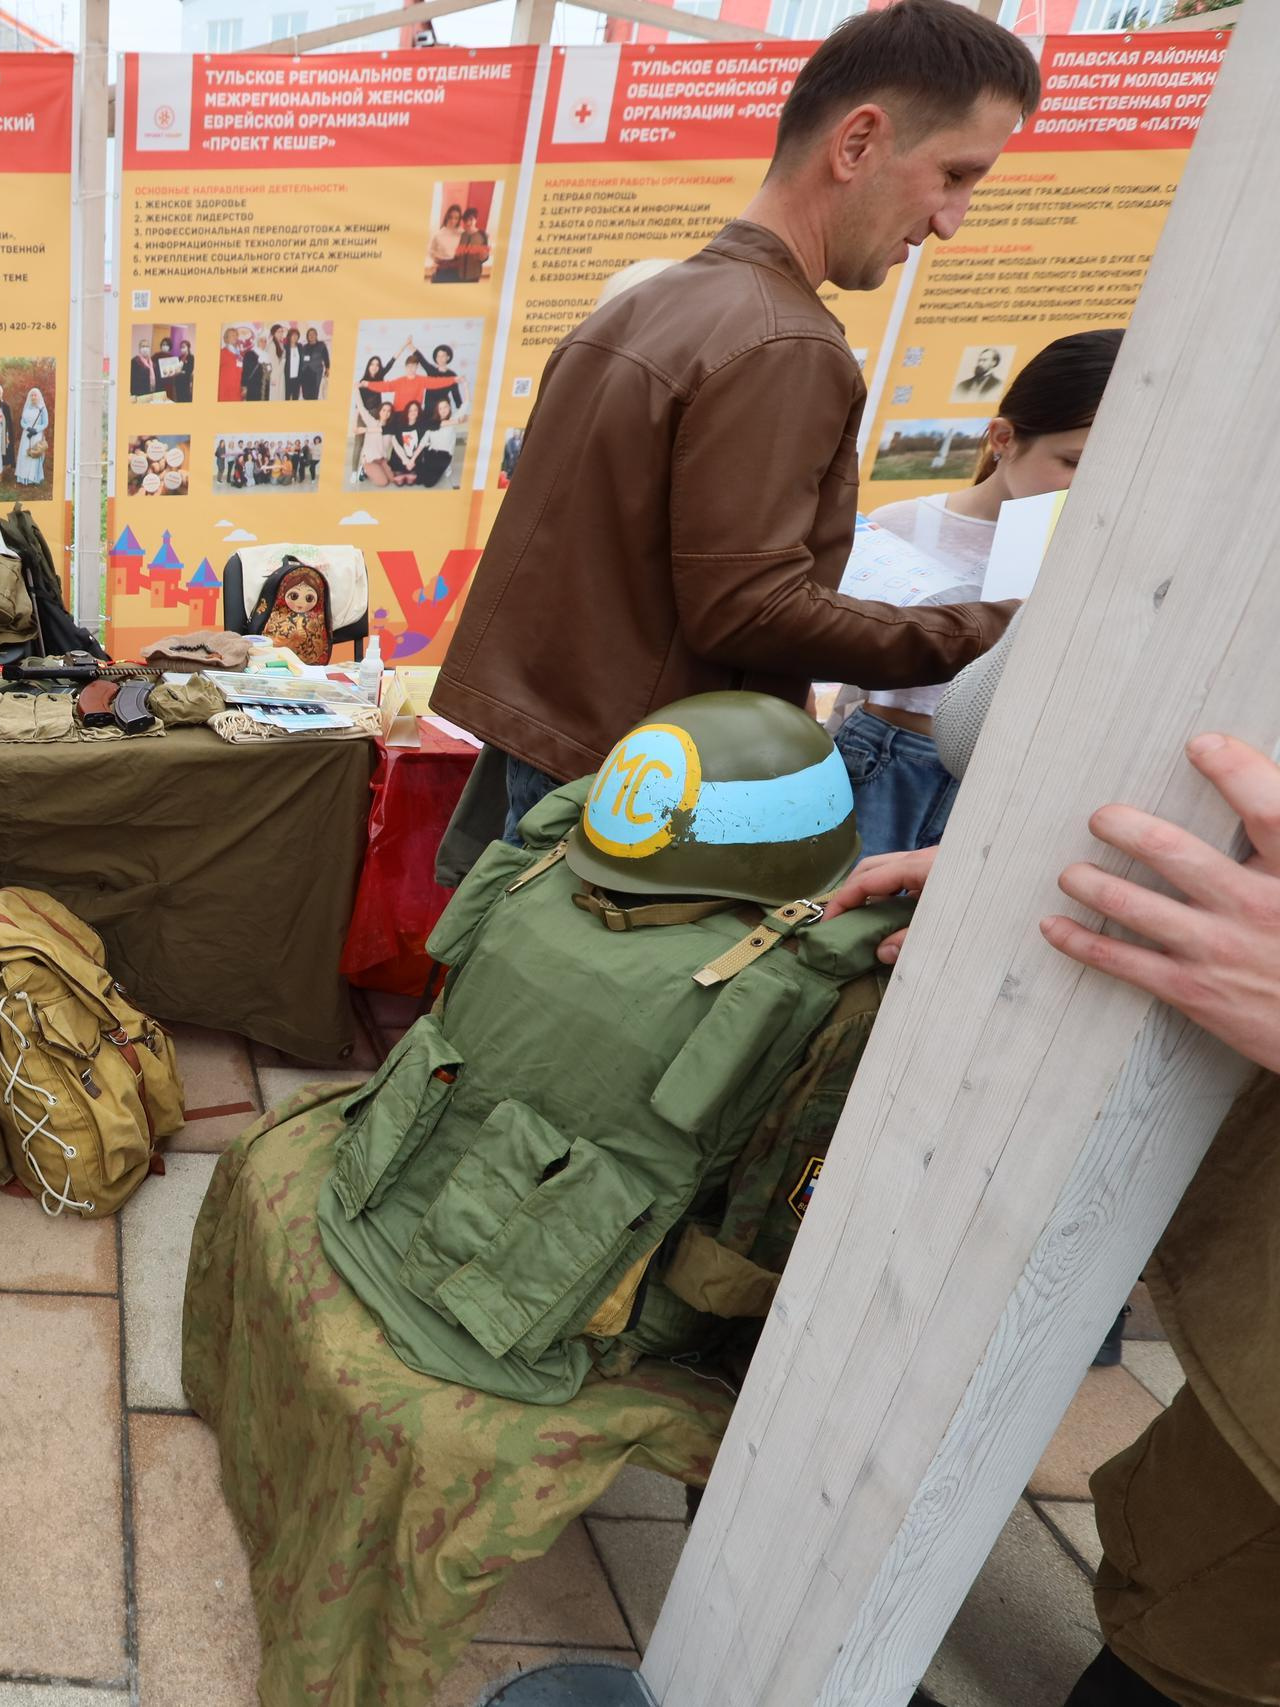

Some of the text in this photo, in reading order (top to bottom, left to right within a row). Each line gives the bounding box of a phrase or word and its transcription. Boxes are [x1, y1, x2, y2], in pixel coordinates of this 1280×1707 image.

[1052, 51, 1140, 66] ПЛАВСКАЯ
[205, 64, 511, 84] ТУЛЬСКОЕ РЕГИОНАЛЬНОЕ ОТДЕЛЕНИЕ
[631, 59, 713, 75] ТУЛЬСКОЕ
[1046, 70, 1217, 89] ОБЛАСТИ МОЛОДЕЖН
[627, 78, 777, 98] ОБЩЕРОССИЙСКОЙ
[205, 88, 444, 106] МЕЖРЕГИОНАЛЬНОЙ ЖЕНСКОЙ
[1040, 95, 1172, 111] ОБЩЕСТВЕННАЯ
[623, 104, 734, 120] ОРГАНИЗАЦИИ
[204, 112, 409, 128] ЕВРЕЙСКОЙ ОРГАНИЗАЦИИ
[1034, 115, 1201, 133] ВОЛОНТЕРОВ «ПАТРИ
[619, 127, 675, 142] КРЕСТ»
[202, 135, 335, 150] «ПРОЕКТ КЕШЕР»
[144, 198, 247, 209] ЖЕНСКОЕ ЗДОРОВЬЕ
[144, 211, 254, 223] ЖЕНСКОЕ ЛИДЕРСТВО
[144, 223, 390, 237] ПРОФЕССИОНАЛЬНАЯ ПЕРЕПОДГОТОВКА ЖЕНЩИН
[144, 237, 378, 250] ИНФОРМАЦИОННЫЕ ТЕХНОЛОГИИ ДЛЯ ЖЕНЩИН
[143, 250, 382, 263] УКРЕПЛЕНИЕ СОЦИАЛЬНОГО СТАТУСА ЖЕНЩИНЫ
[2, 272, 28, 283] ТЕМЕ
[143, 263, 339, 277] МЕЖНАЦИОНАЛЬНЫЙ ЖЕНСКИЙ ДИАЛОГ
[157, 292, 283, 304] WWW.PROJECTKESHER.RU
[8, 320, 57, 331] 420-72-86
